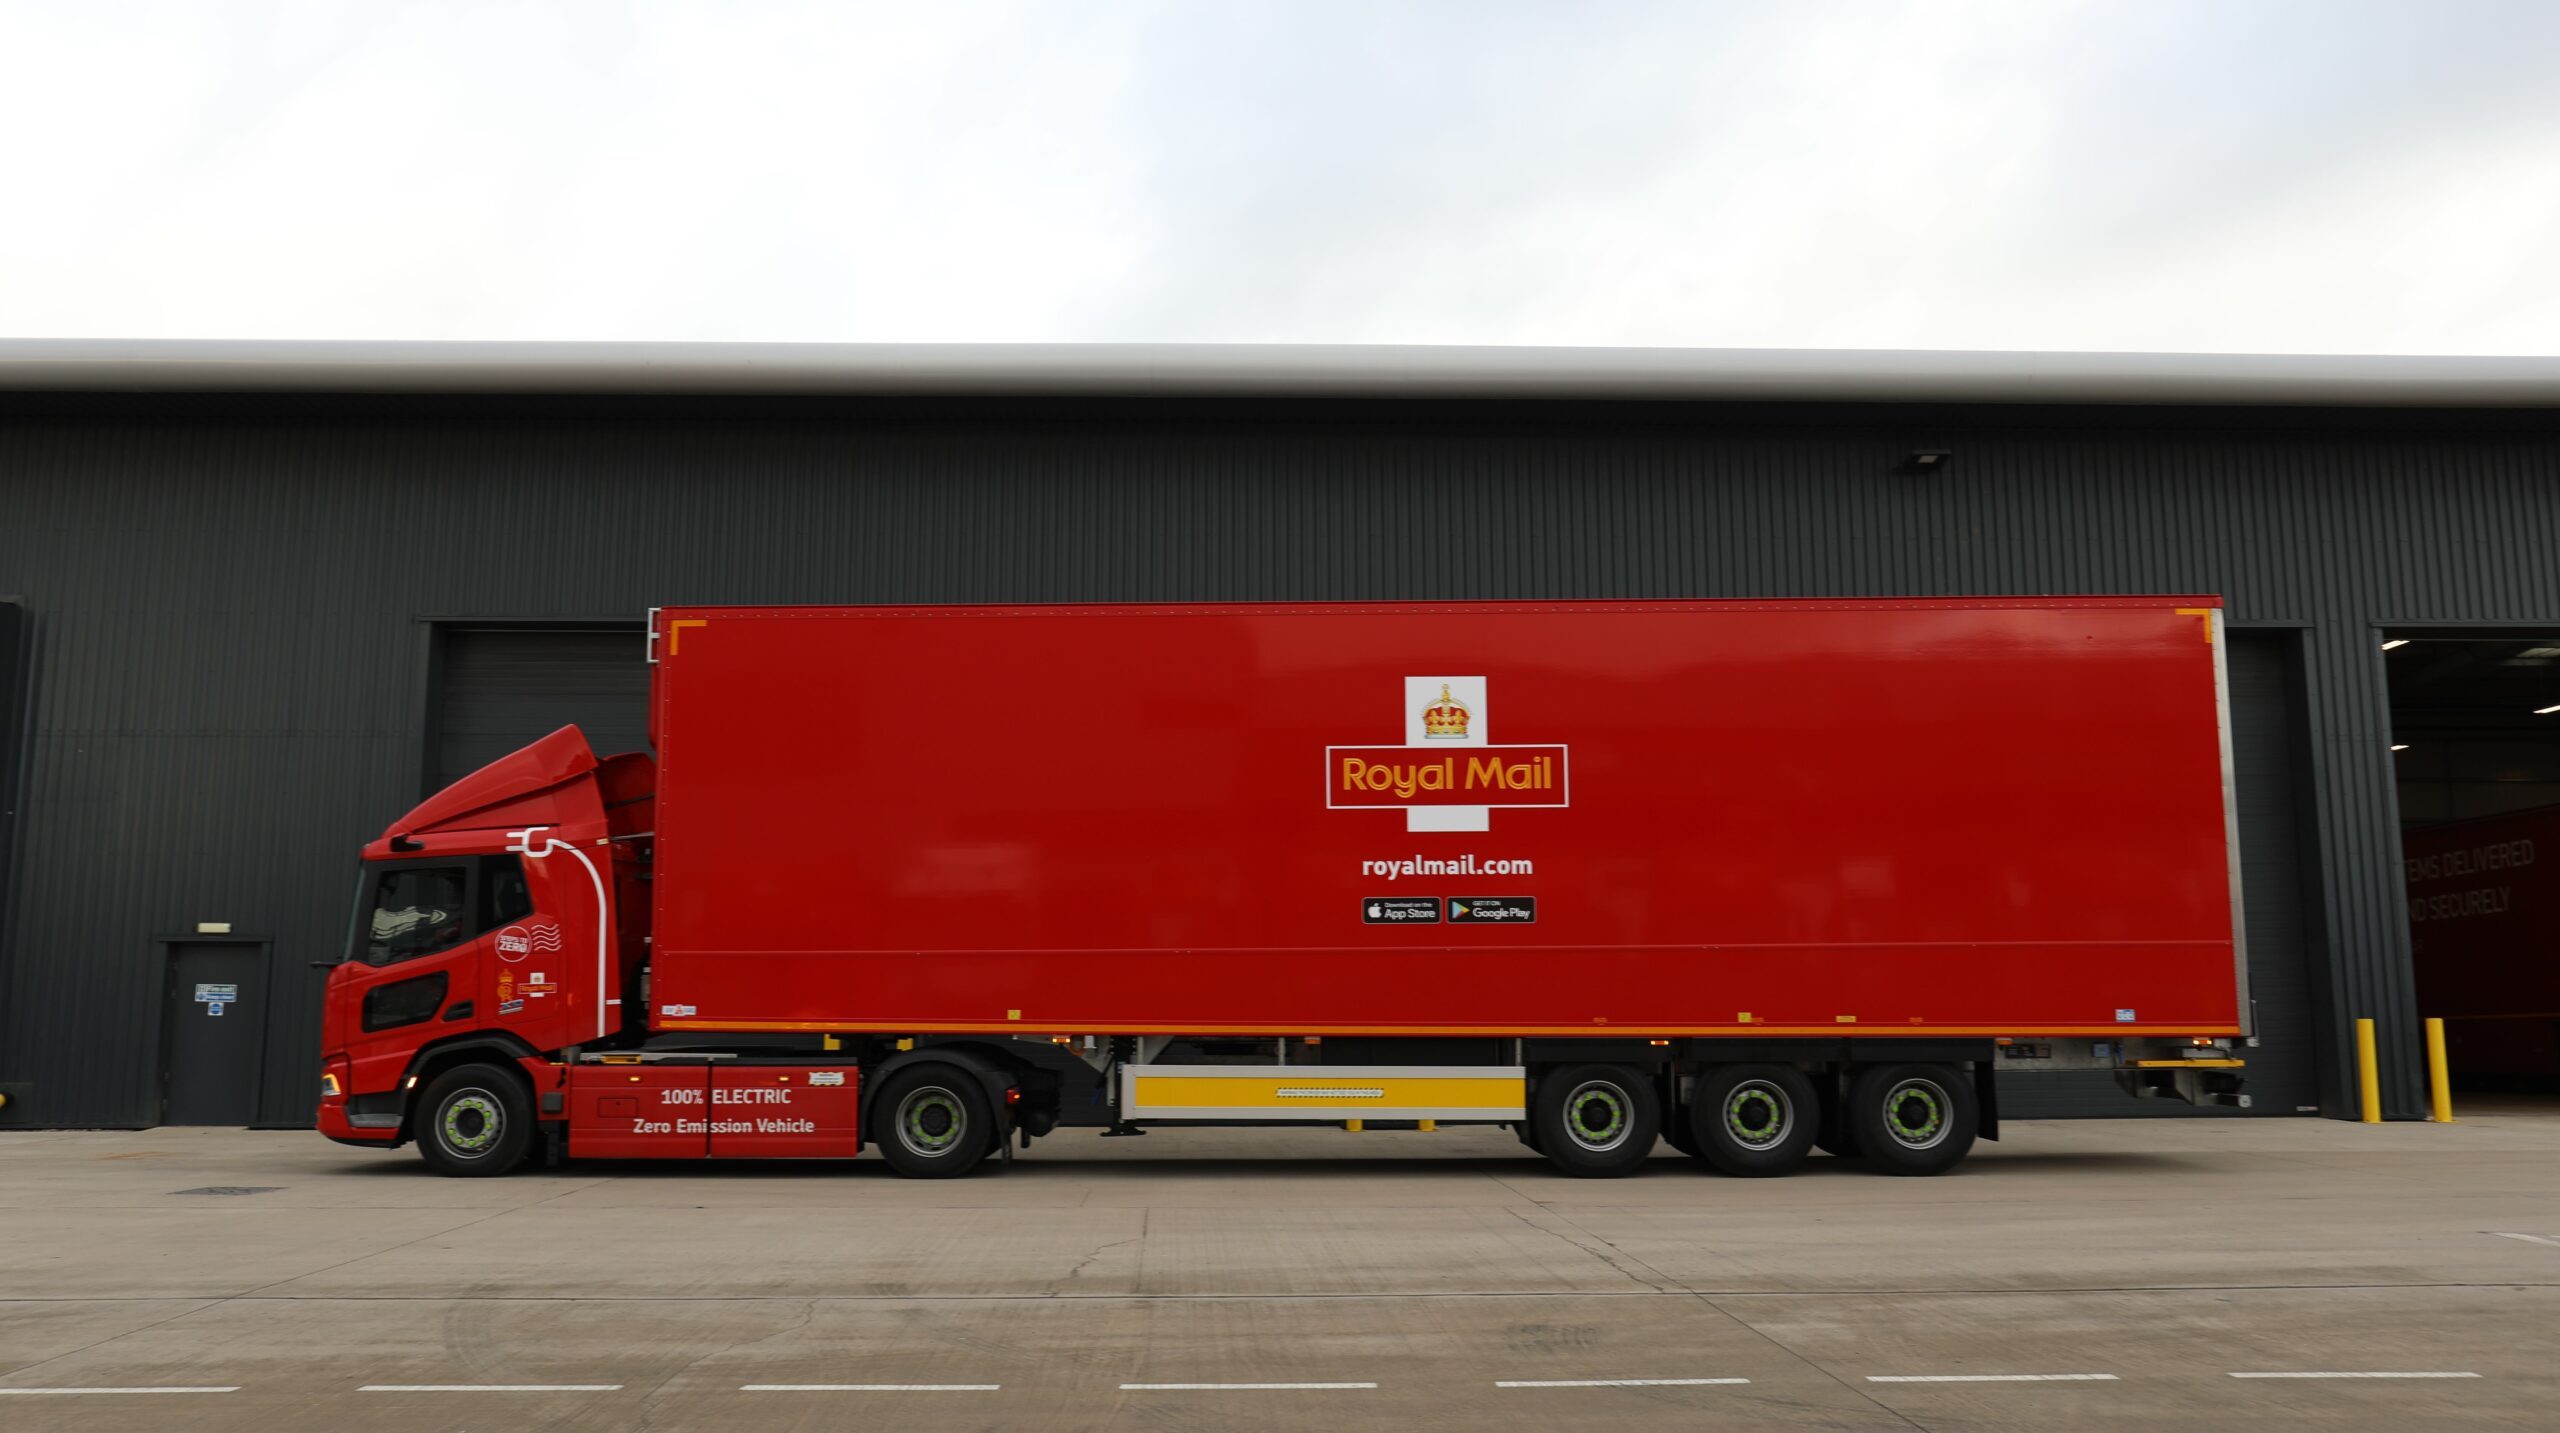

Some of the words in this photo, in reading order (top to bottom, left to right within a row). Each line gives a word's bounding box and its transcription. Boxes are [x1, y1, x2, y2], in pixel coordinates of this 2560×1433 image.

[1343, 757, 1453, 798] Royal
[1465, 756, 1552, 790] Mail
[2443, 839, 2535, 877] DELIVERED
[1362, 854, 1533, 880] royalmail.com
[2410, 897, 2426, 921] ND
[2430, 885, 2511, 920] SECURELY
[1384, 908, 1406, 920] App
[1407, 908, 1436, 918] Store
[1472, 907, 1509, 920] Google
[1509, 907, 1531, 920] Play
[499, 941, 528, 953] ZERO
[660, 1089, 704, 1105] 100%
[712, 1089, 792, 1104] ELECTRIC
[633, 1118, 671, 1134] Zero
[676, 1118, 753, 1134] Emission
[757, 1118, 815, 1133] Vehicle
